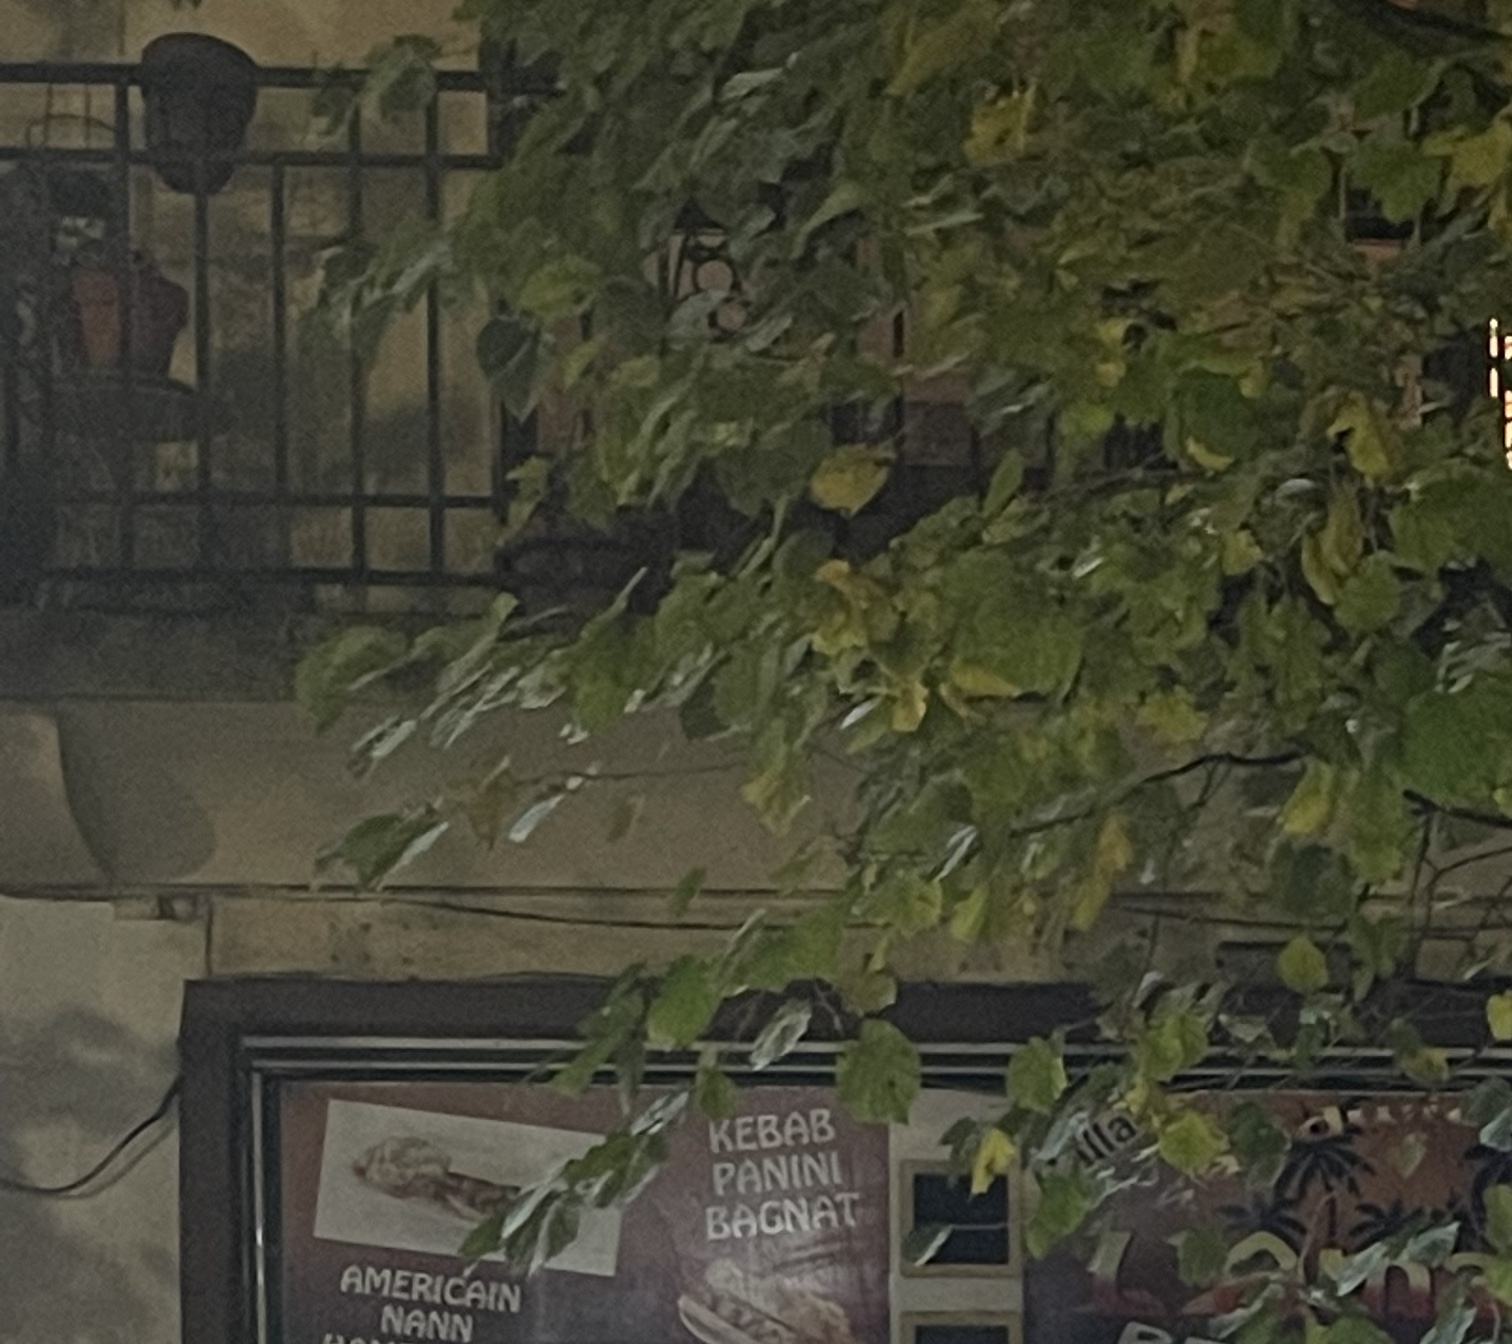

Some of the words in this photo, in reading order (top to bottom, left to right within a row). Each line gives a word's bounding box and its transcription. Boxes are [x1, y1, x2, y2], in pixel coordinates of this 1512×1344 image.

[709, 1108, 836, 1153] KEBAB
[713, 1151, 843, 1196] PANINI
[705, 1192, 860, 1241] BAGNAT
[340, 1264, 522, 1314] AMERICAIN
[380, 1304, 473, 1343] NANN
